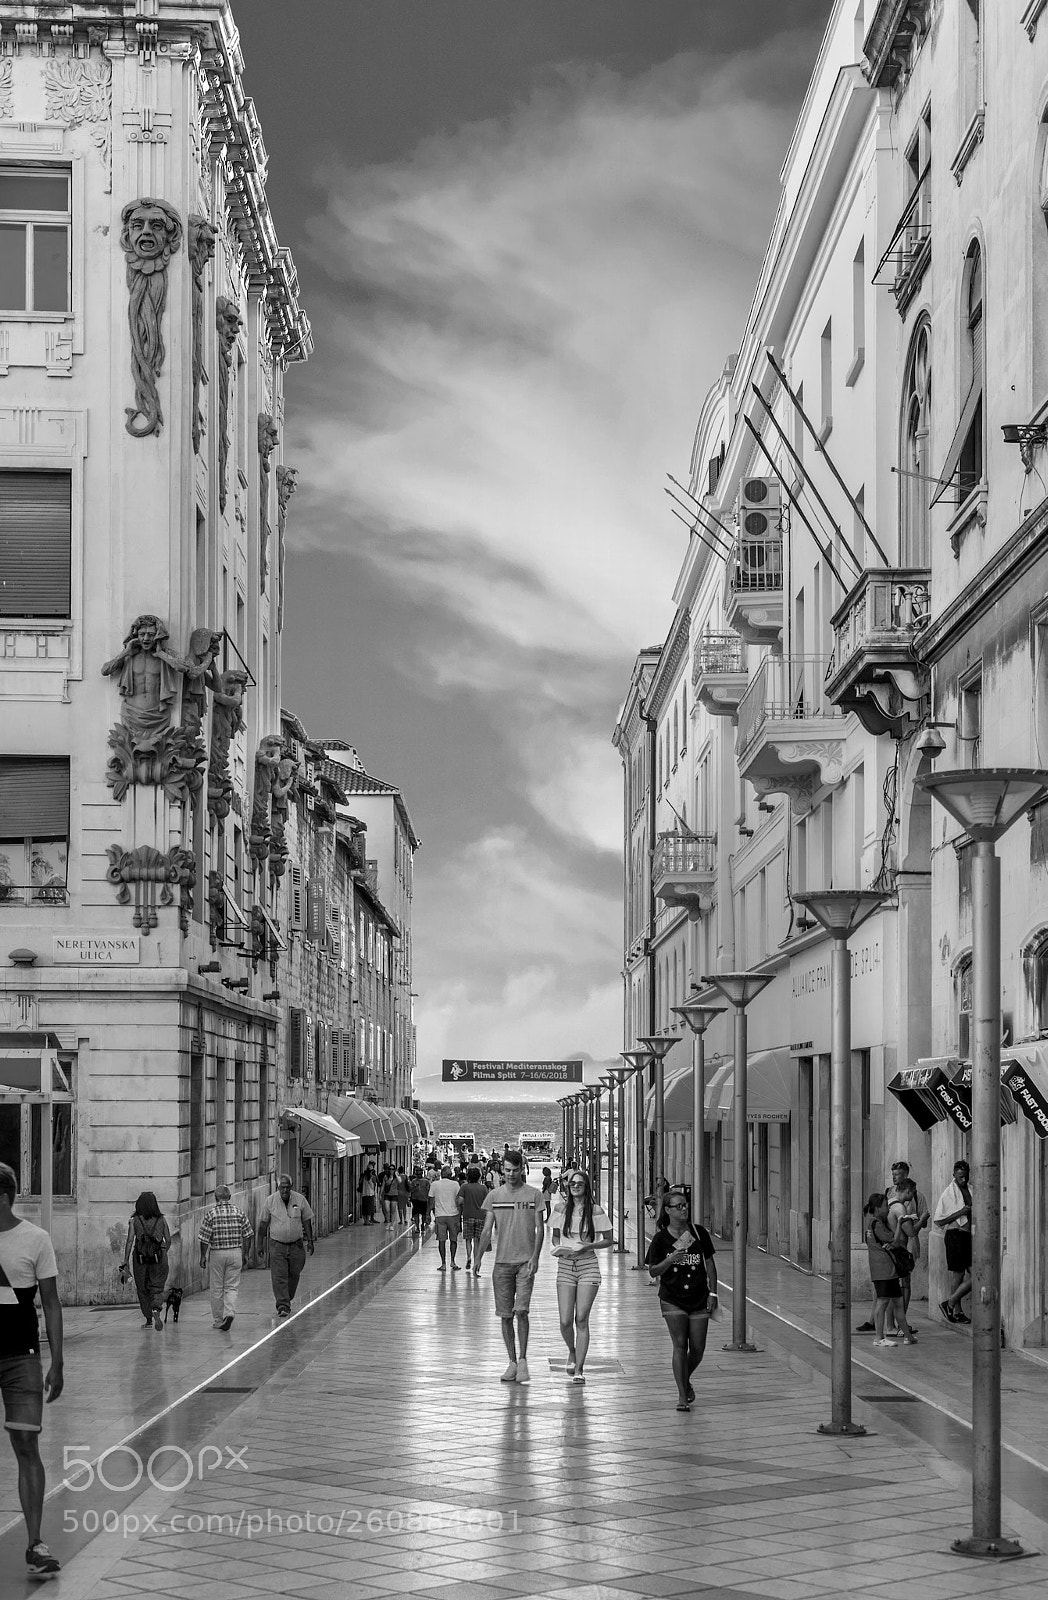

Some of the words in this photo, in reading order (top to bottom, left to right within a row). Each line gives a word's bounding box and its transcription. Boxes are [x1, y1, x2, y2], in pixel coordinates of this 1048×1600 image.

[56, 940, 136, 949] NERETVANSKA
[80, 951, 112, 960] ULICA
[472, 1062, 504, 1070] Festival
[506, 1062, 567, 1072] Mediteranskog
[472, 1071, 496, 1079] Filma
[497, 1071, 517, 1080] Split
[1020, 1088, 1039, 1109] FAST
[936, 1084, 955, 1106] Fast
[952, 1105, 972, 1128] Food
